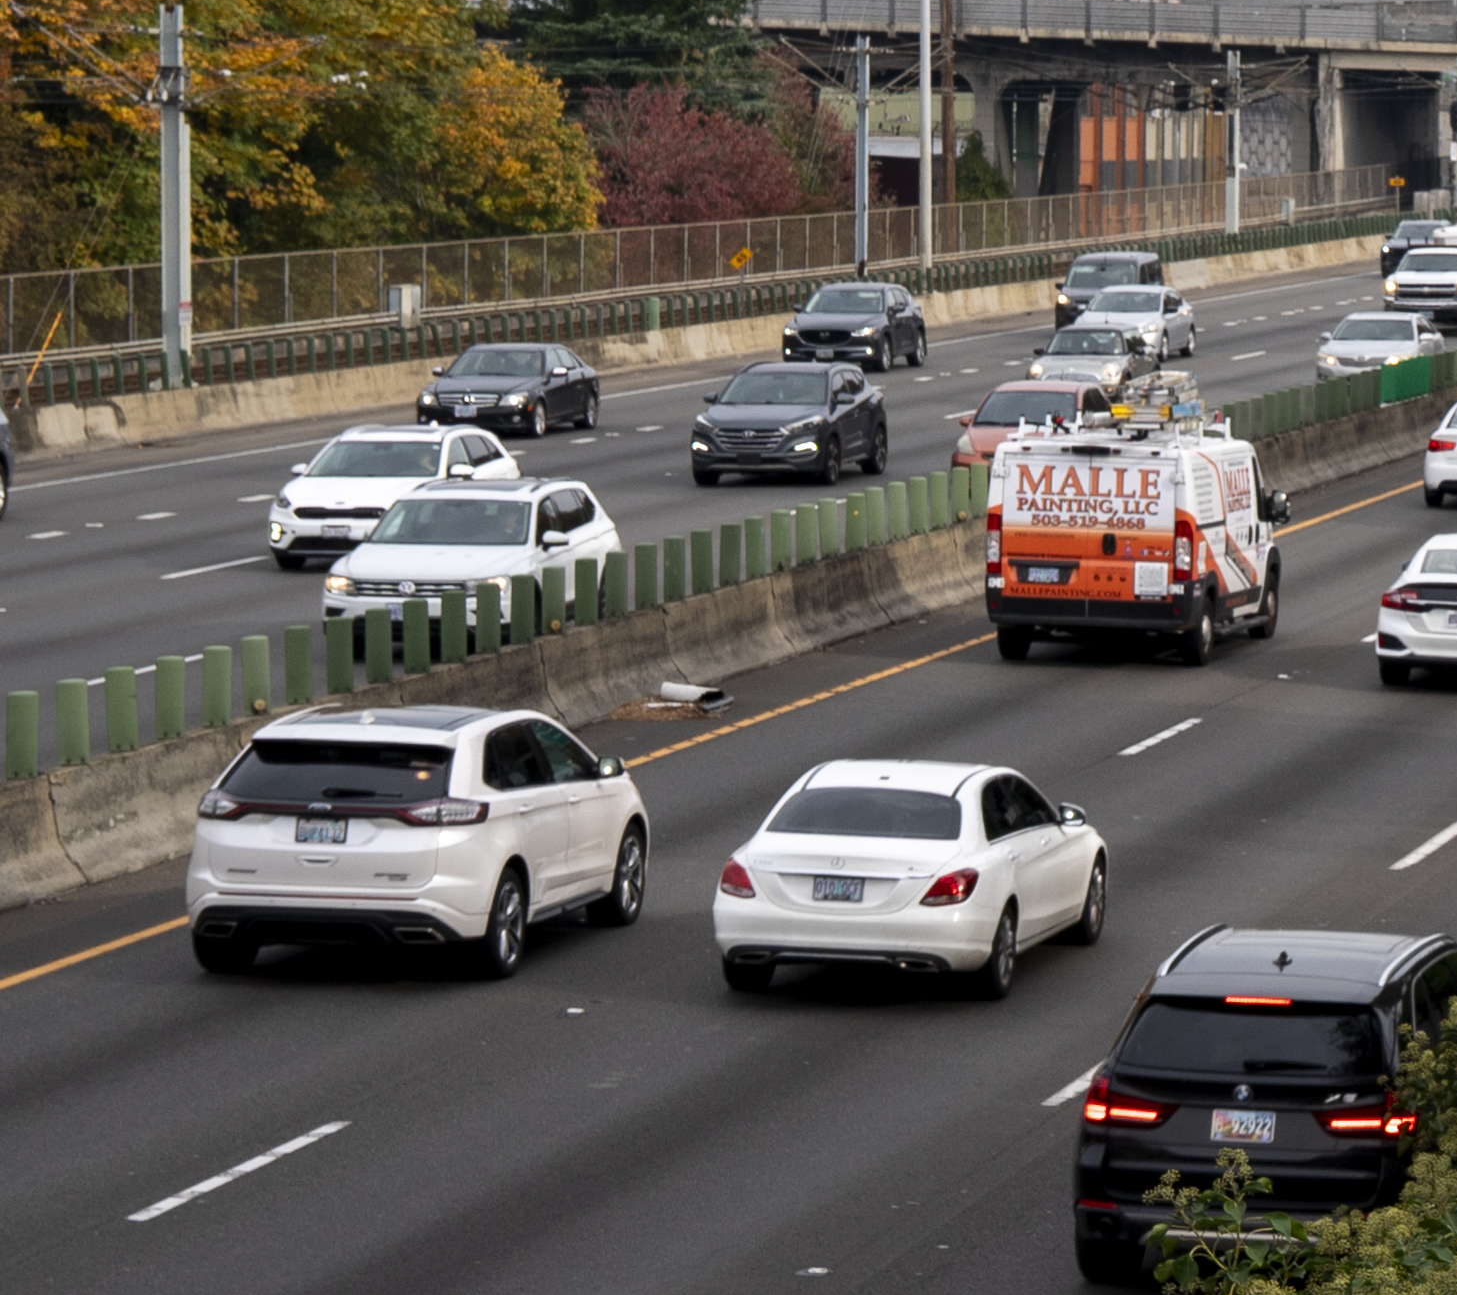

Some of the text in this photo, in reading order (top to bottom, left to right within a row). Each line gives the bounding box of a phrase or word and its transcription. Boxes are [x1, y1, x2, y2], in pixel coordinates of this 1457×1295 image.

[1016, 464, 1161, 500] MALLE
[1016, 496, 1159, 518] PAINTING, LLC
[1031, 513, 1146, 530] 503-519-4868
[1010, 586, 1122, 599] MALLEPAINTING.COM
